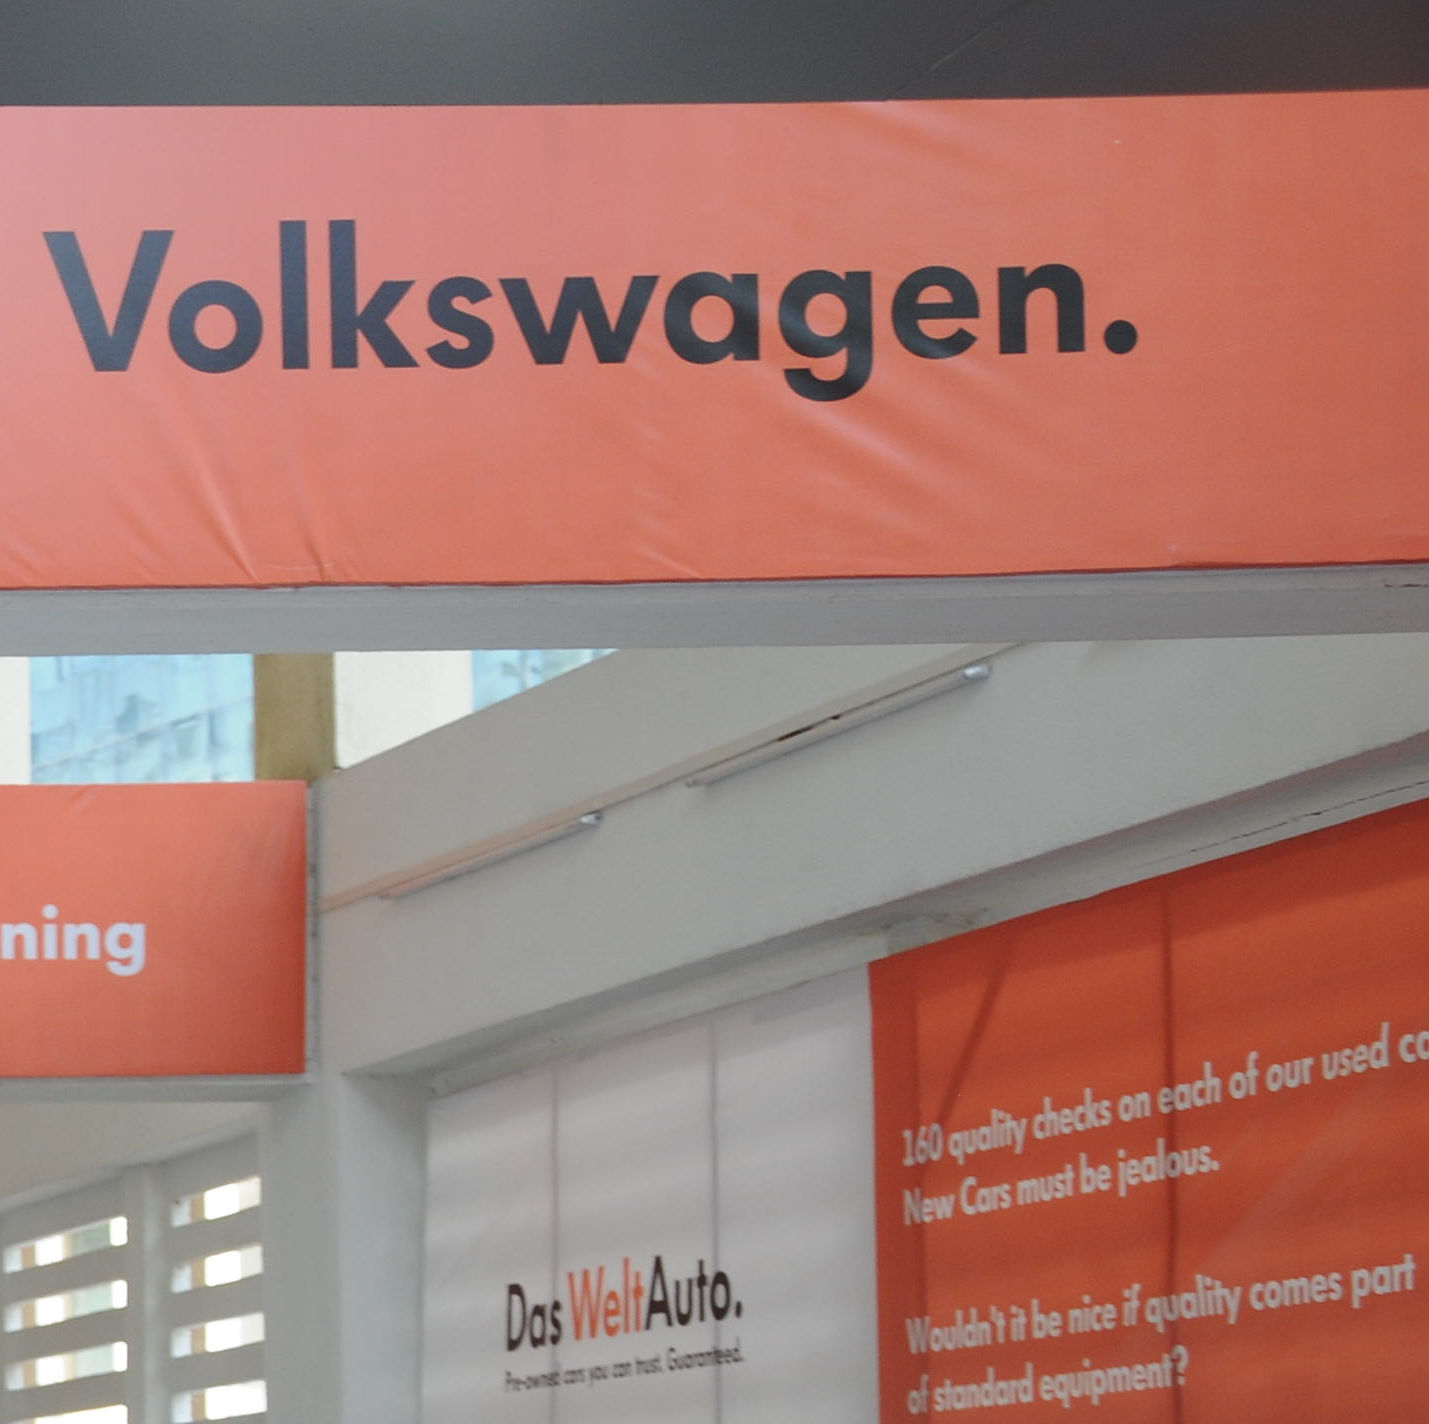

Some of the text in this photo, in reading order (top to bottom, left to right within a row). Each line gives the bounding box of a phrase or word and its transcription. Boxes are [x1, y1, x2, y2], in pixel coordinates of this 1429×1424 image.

[44, 219, 1138, 402] Volkswagen.
[903, 1123, 943, 1167] 160
[948, 1108, 1028, 1166] quality
[1032, 1088, 1112, 1139] checks
[1118, 1091, 1151, 1122] on
[1156, 1061, 1221, 1114] each
[1229, 1051, 1259, 1099] of
[1266, 1057, 1314, 1091] our
[1321, 1022, 1389, 1080] used
[903, 1137, 1221, 1226] New Cars must be jealous.
[507, 1255, 744, 1351] Das WeltAuto.
[905, 1253, 1416, 1354] Wouldn't it be nice if quality comes part
[907, 1345, 1189, 1414] of standard equipment?
